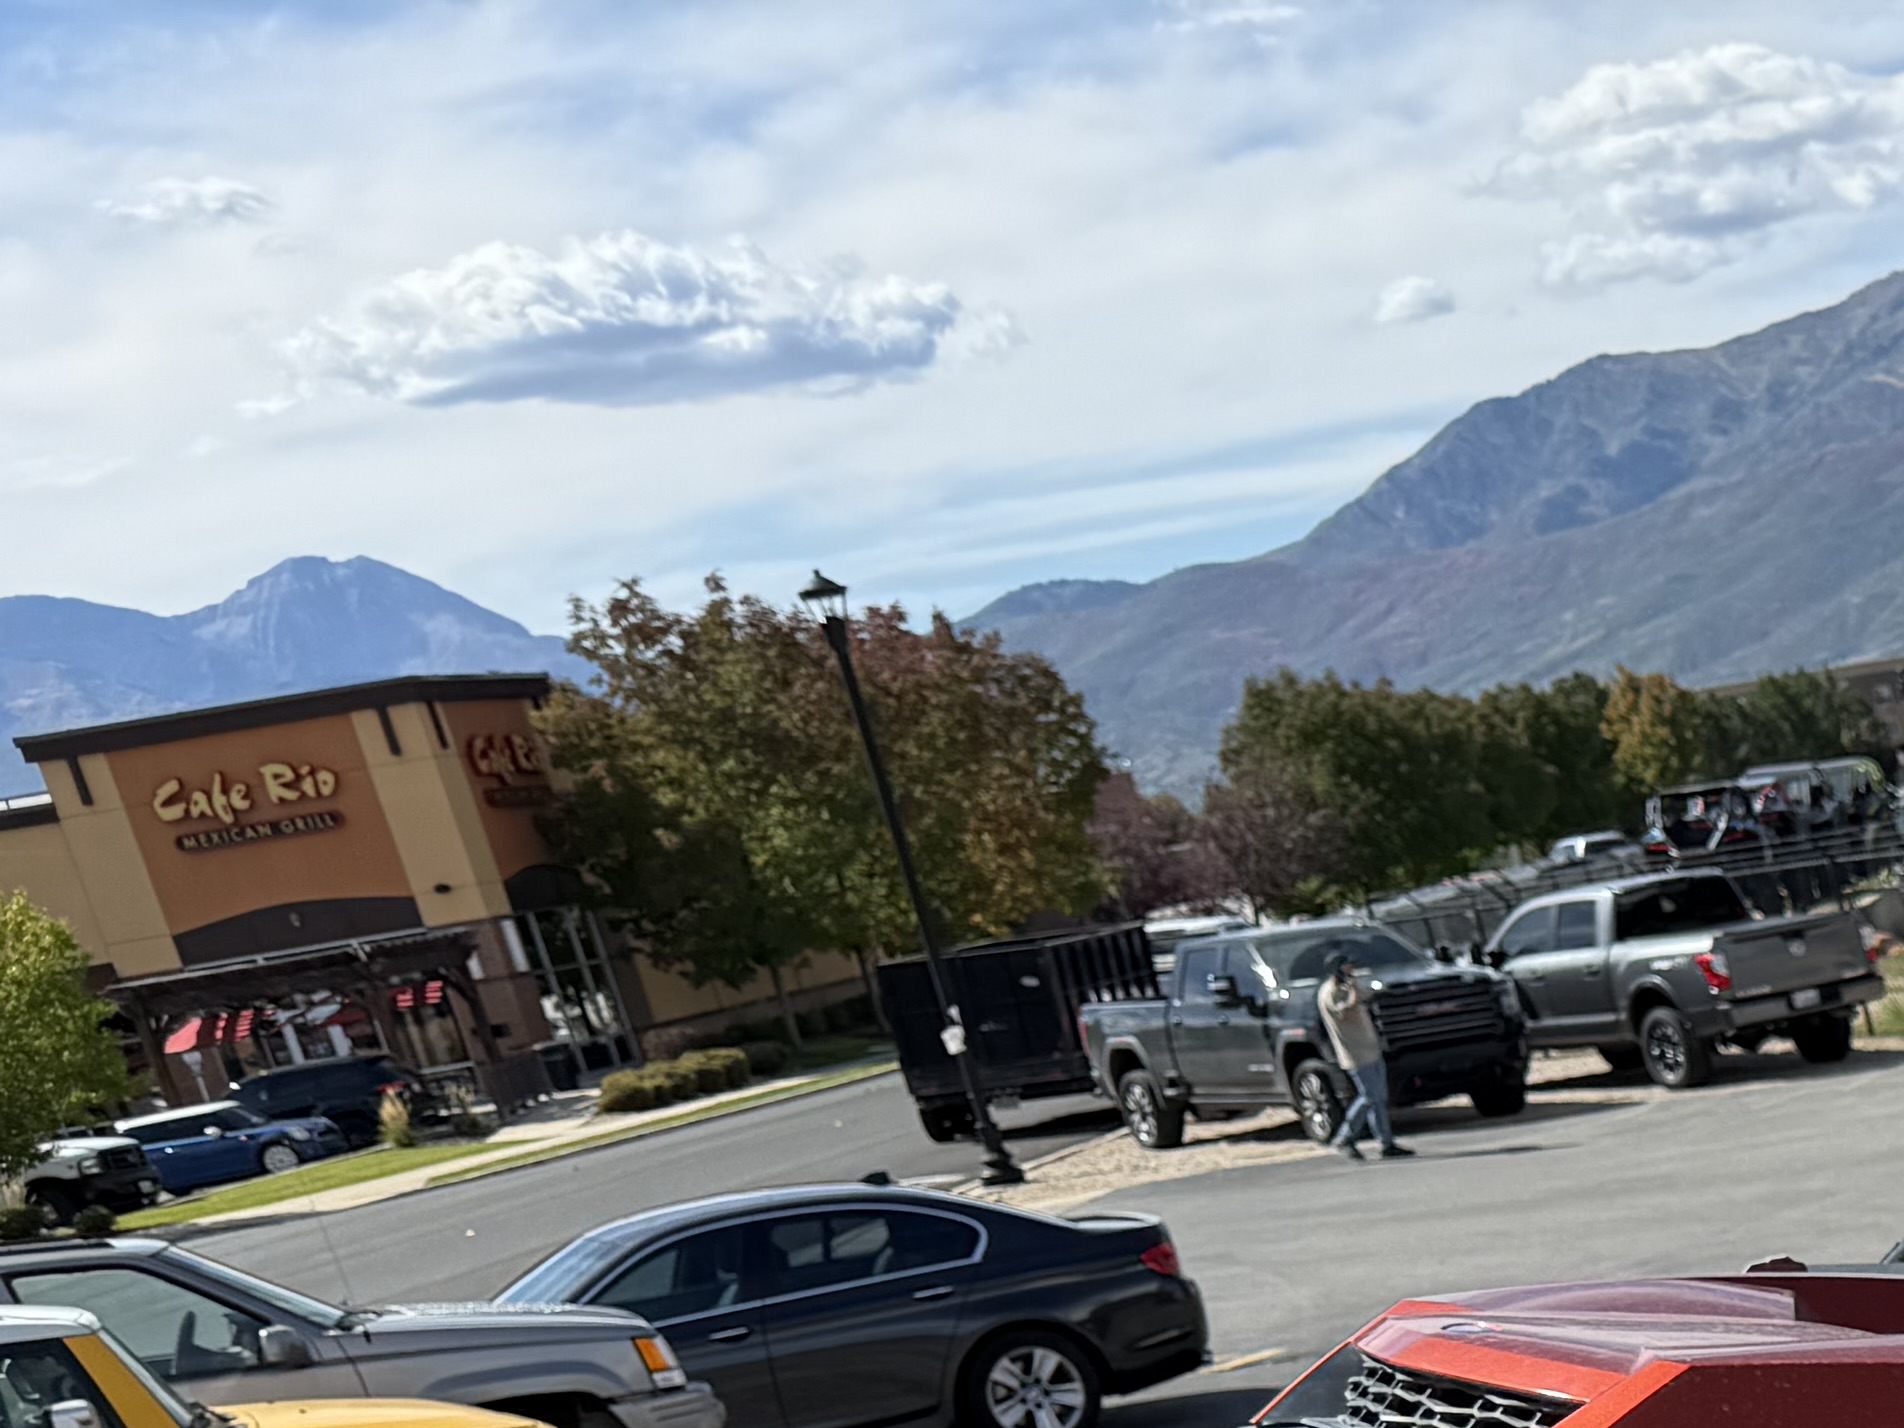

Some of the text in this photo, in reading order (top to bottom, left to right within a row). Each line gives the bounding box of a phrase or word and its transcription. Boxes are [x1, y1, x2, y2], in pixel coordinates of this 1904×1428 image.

[154, 763, 336, 824] Cafe Rio
[182, 813, 336, 850] MEXICAN GRILL
